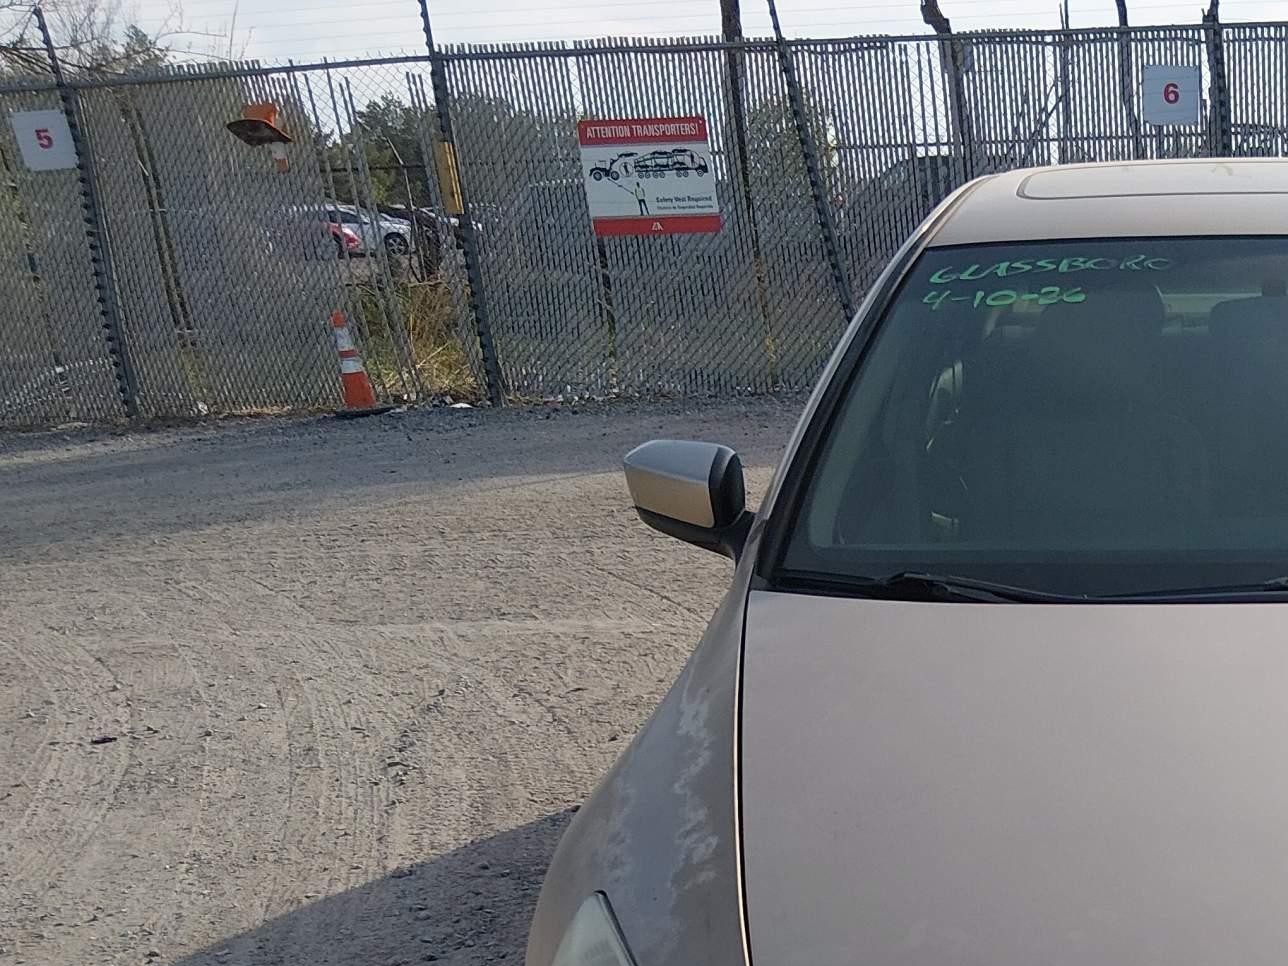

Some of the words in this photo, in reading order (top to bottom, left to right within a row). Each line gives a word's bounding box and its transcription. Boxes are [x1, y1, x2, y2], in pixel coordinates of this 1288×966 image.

[1163, 82, 1180, 105] 6
[34, 127, 54, 149] 5
[586, 126, 631, 139] ATTENTION
[632, 123, 699, 137] TRANSPORTERS!
